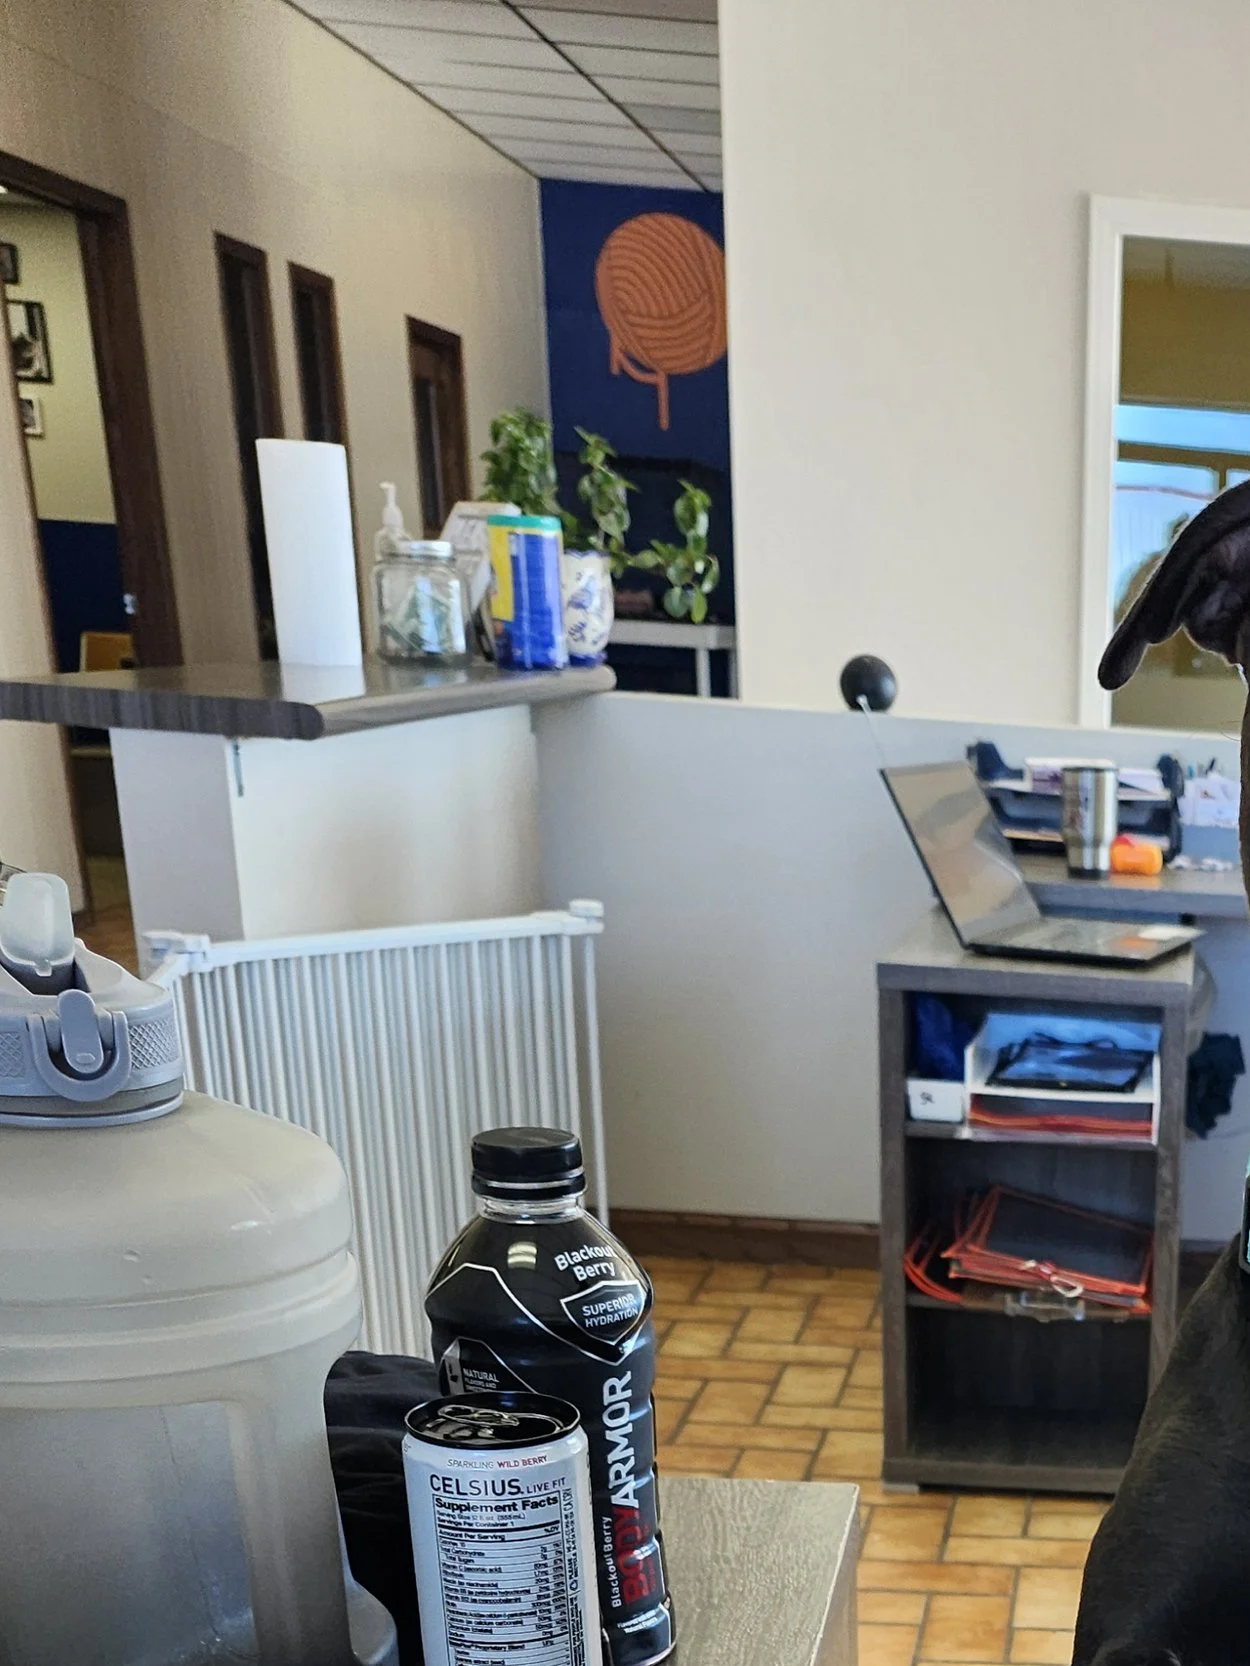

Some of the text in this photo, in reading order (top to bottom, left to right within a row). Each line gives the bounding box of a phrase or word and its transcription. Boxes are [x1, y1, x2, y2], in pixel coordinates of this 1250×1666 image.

[573, 1262, 616, 1282] Berry
[582, 1293, 637, 1317] SUPERIOR
[585, 1306, 639, 1328] HYDRATION
[463, 1367, 500, 1383] NATURAL
[447, 1455, 548, 1469] SPARKLING WILD BERRY
[526, 1481, 549, 1494] LIVE
[551, 1477, 567, 1489] FIT
[435, 1495, 559, 1514] Supplement Facts
[438, 1530, 506, 1542] Amount Per Serving
[602, 1516, 622, 1608] Blackout Berry
